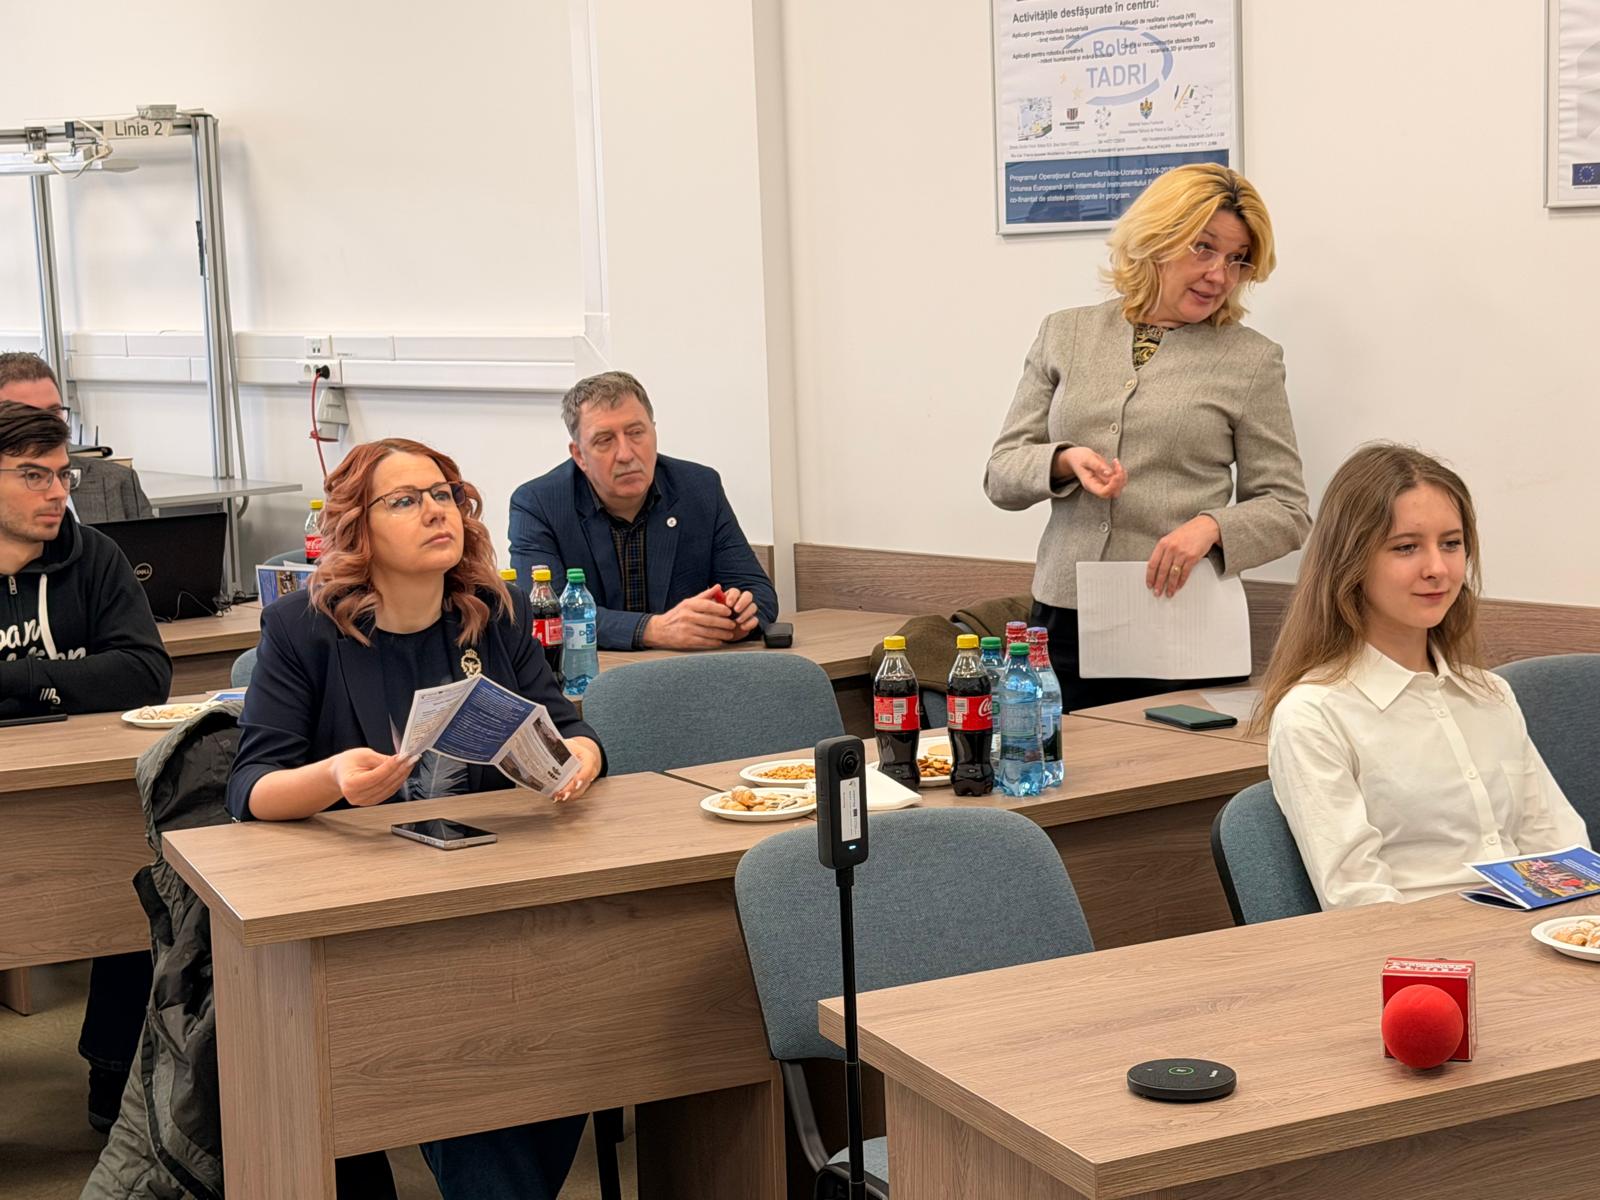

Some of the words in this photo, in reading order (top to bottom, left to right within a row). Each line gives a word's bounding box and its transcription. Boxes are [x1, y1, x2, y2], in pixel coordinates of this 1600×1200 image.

[1060, 3, 1112, 19] desfășurate
[1114, 2, 1123, 12] în
[1126, 0, 1159, 11] centru:
[1093, 38, 1138, 57] RoUa
[1086, 63, 1147, 88] TADRI
[114, 120, 149, 136] Linia
[153, 120, 163, 136] 2
